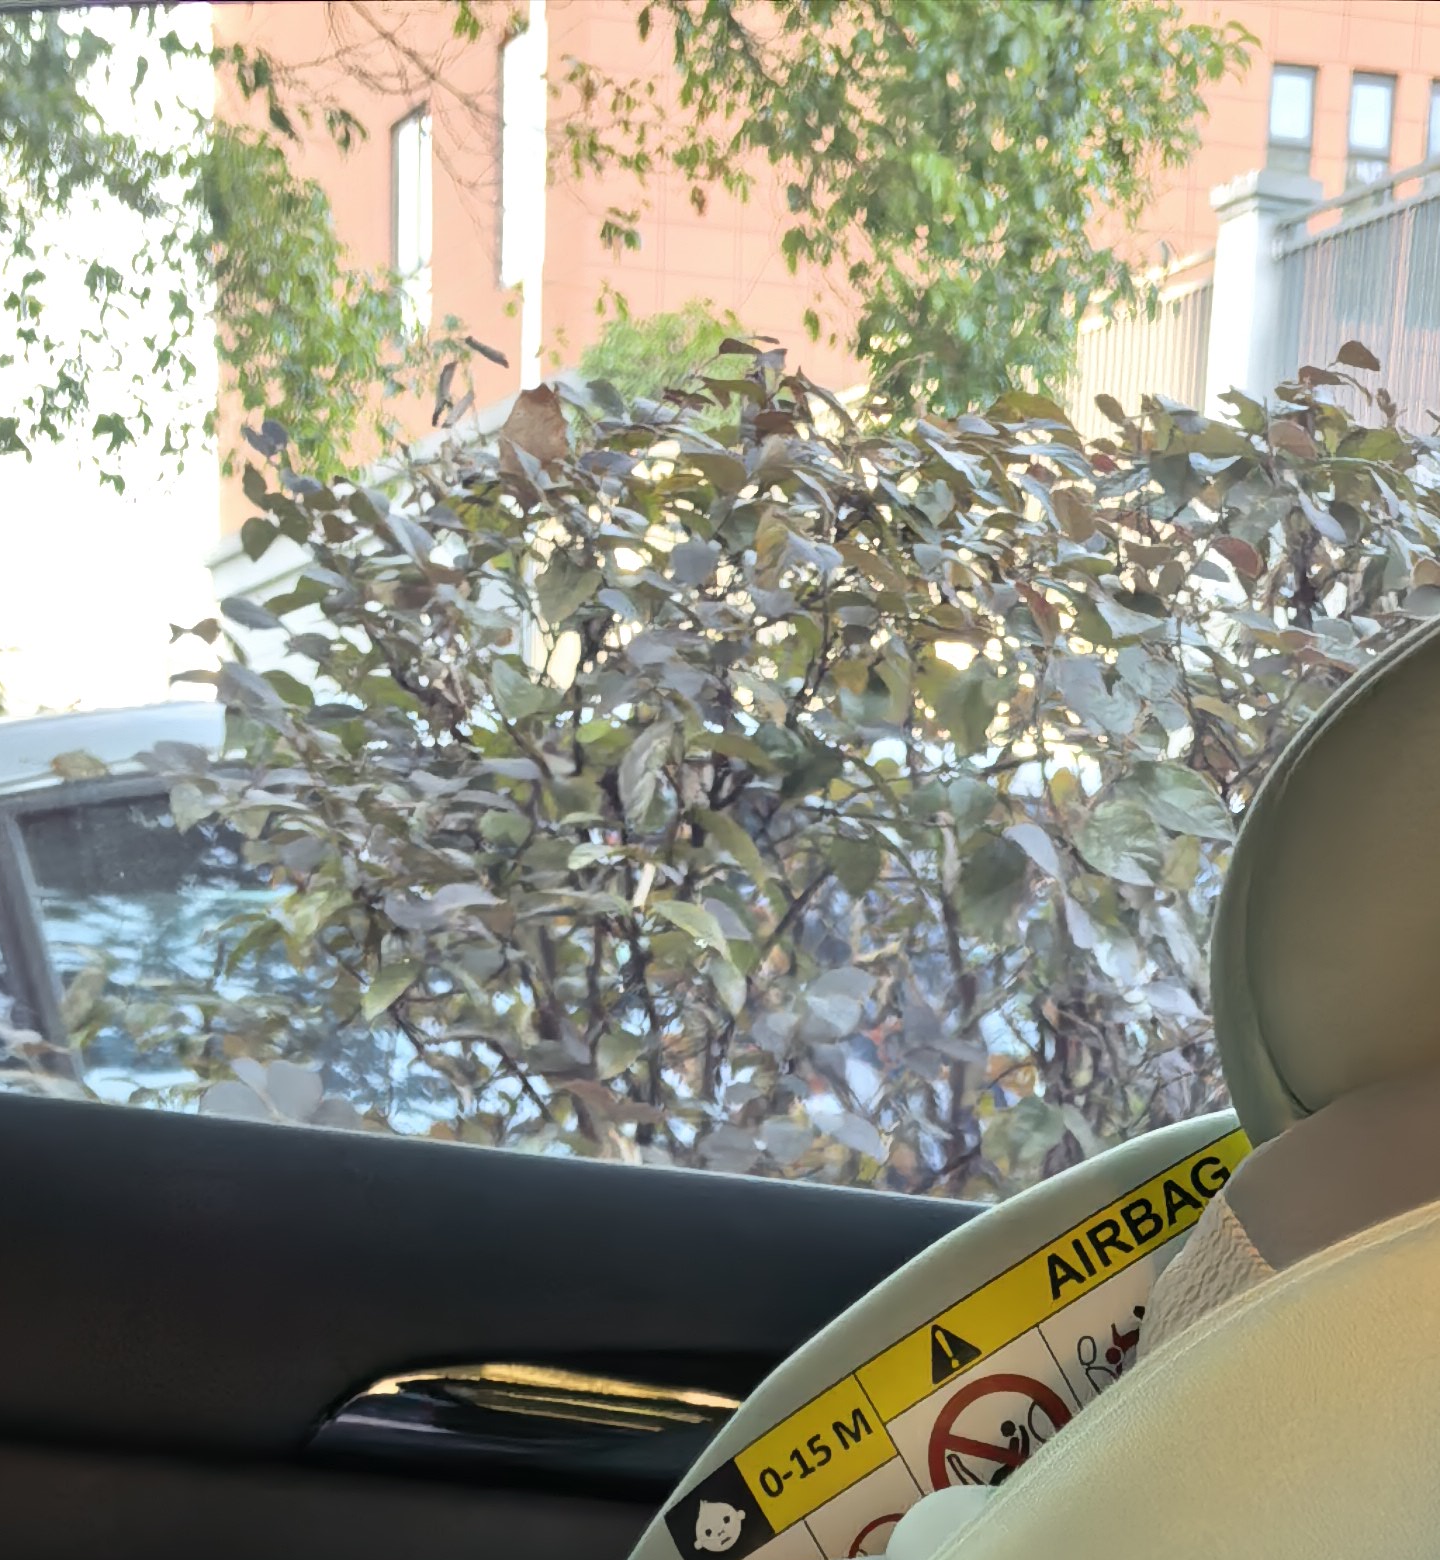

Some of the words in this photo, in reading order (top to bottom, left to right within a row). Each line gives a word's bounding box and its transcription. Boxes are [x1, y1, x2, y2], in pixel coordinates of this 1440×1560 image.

[1047, 1156, 1231, 1301] AIRBAG
[759, 1433, 832, 1498] 0-15
[832, 1407, 873, 1450] M
